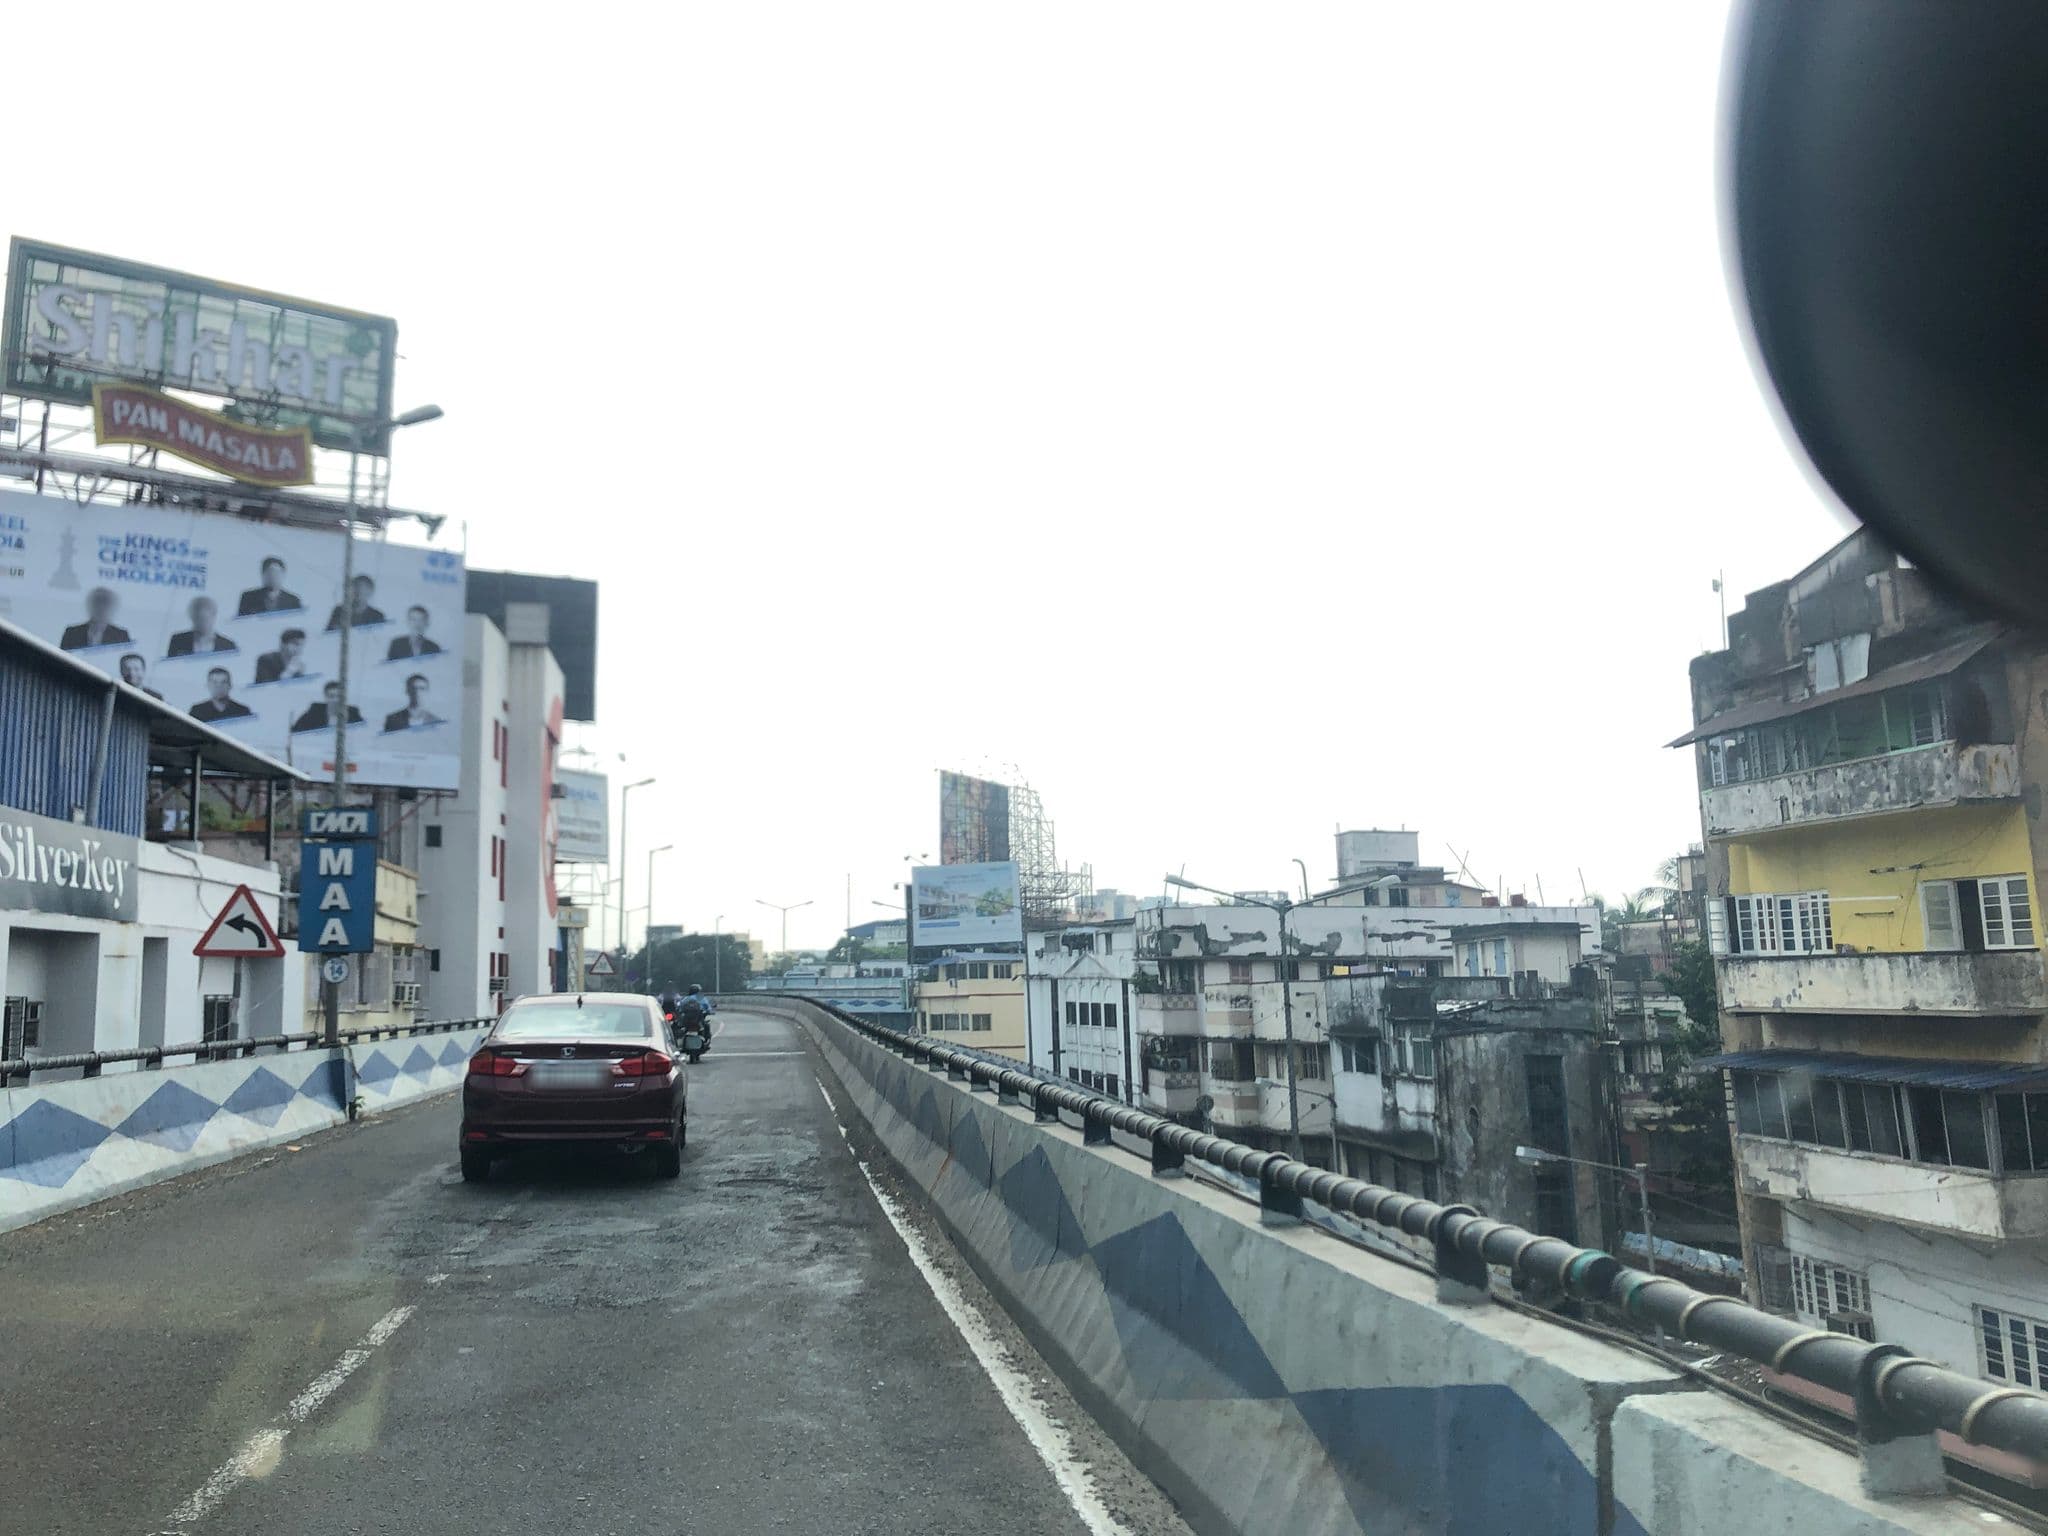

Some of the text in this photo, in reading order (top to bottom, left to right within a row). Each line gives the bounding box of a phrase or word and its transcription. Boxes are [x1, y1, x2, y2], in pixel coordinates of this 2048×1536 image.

[31, 284, 360, 405] Shikhar
[113, 398, 297, 471] PAN MASALA
[98, 548, 163, 568] CHESS
[125, 532, 190, 556] KINGS
[318, 847, 354, 946] MAA
